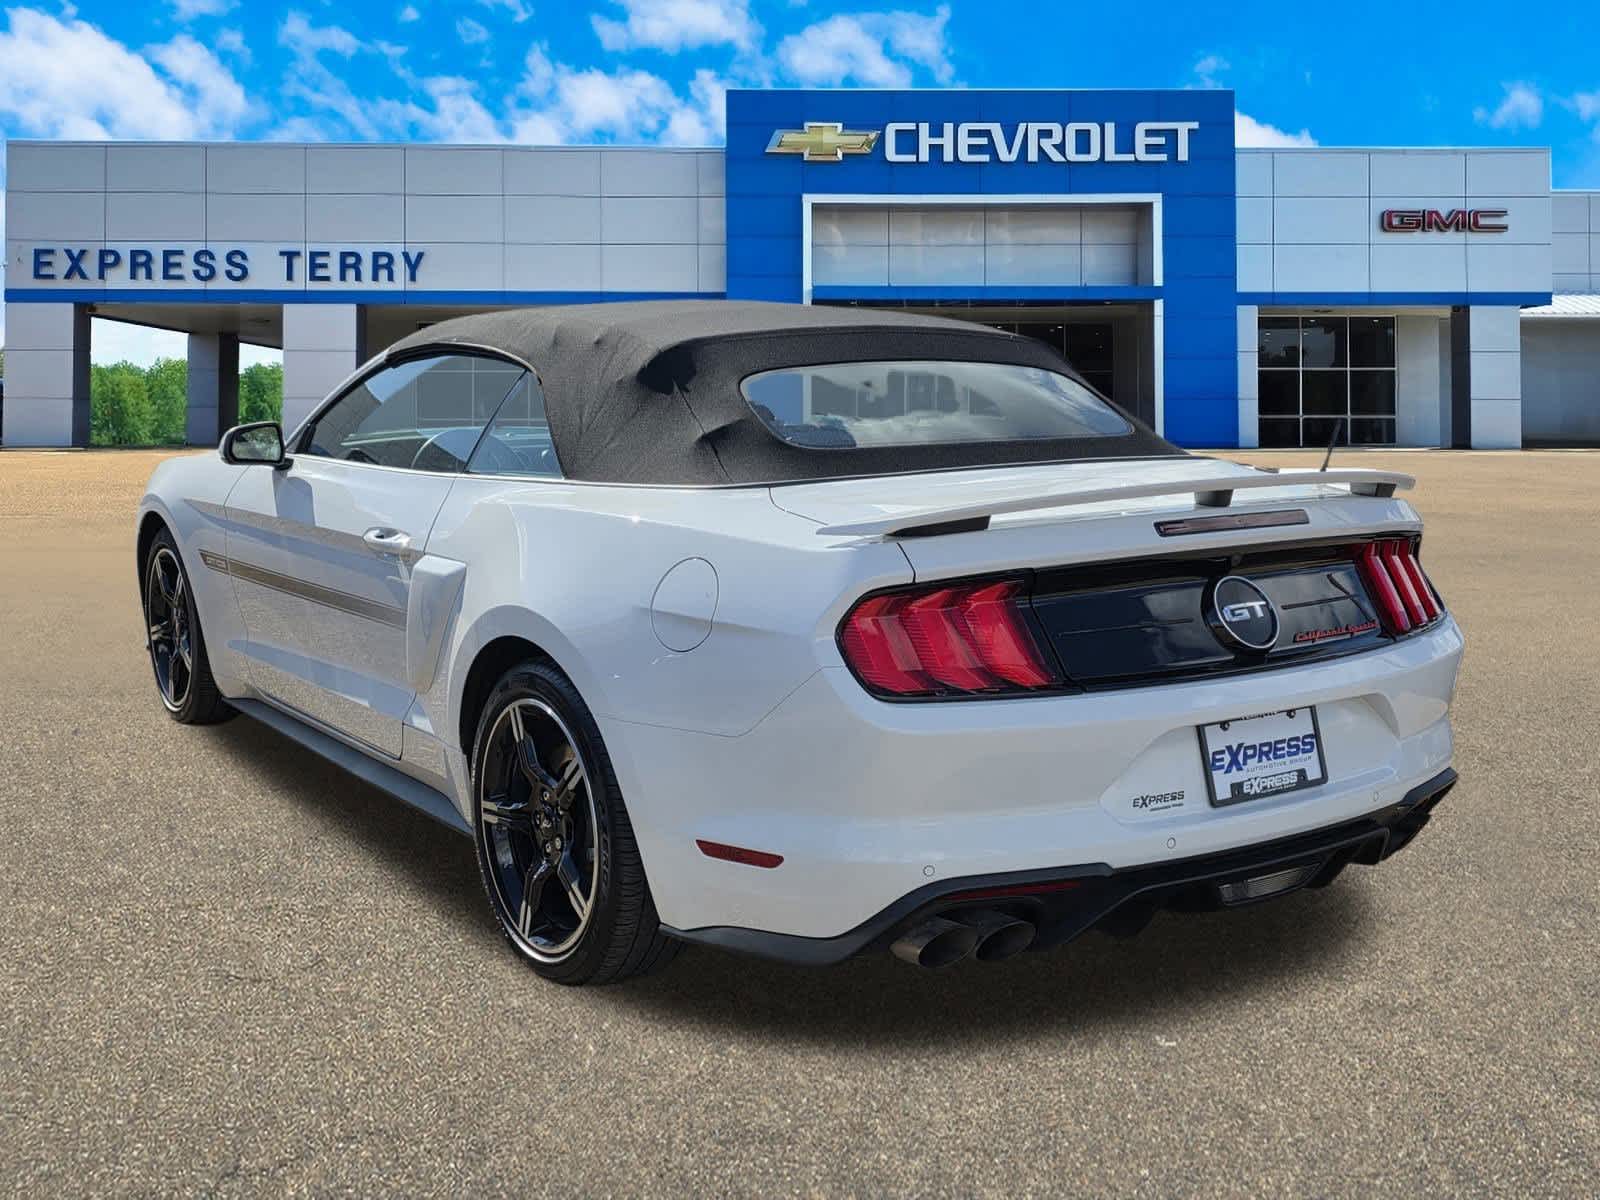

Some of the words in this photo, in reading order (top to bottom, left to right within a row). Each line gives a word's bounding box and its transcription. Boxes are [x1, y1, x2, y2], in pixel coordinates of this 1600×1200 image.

[885, 122, 1200, 162] CHEVROLET
[1382, 208, 1509, 232] GMC
[32, 247, 249, 281] EXPRESS
[279, 250, 425, 282] TERRY
[1222, 601, 1267, 622] GT
[1211, 734, 1315, 774] EXPRESS
[1243, 771, 1298, 794] EXPRESS
[1132, 790, 1185, 808] EXPRESS
